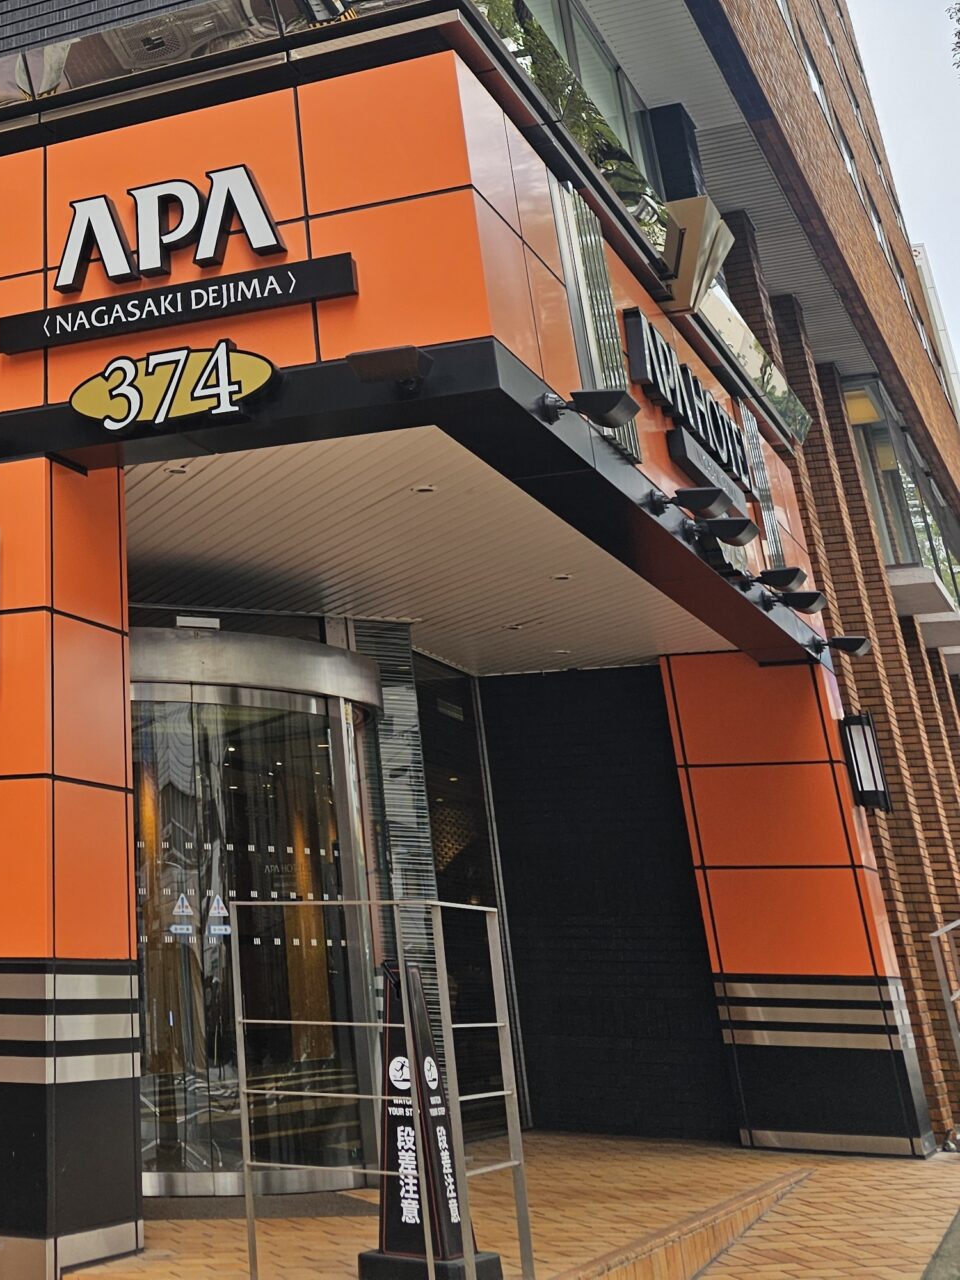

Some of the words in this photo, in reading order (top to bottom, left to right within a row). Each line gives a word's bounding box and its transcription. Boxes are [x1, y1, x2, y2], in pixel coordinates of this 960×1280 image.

[54, 164, 288, 293] APA
[101, 339, 242, 431] 374
[636, 306, 698, 431] APA
[387, 1106, 405, 1117] YOUR
[396, 1125, 421, 1224] 段差注意
[436, 1125, 461, 1224] 段差注意
